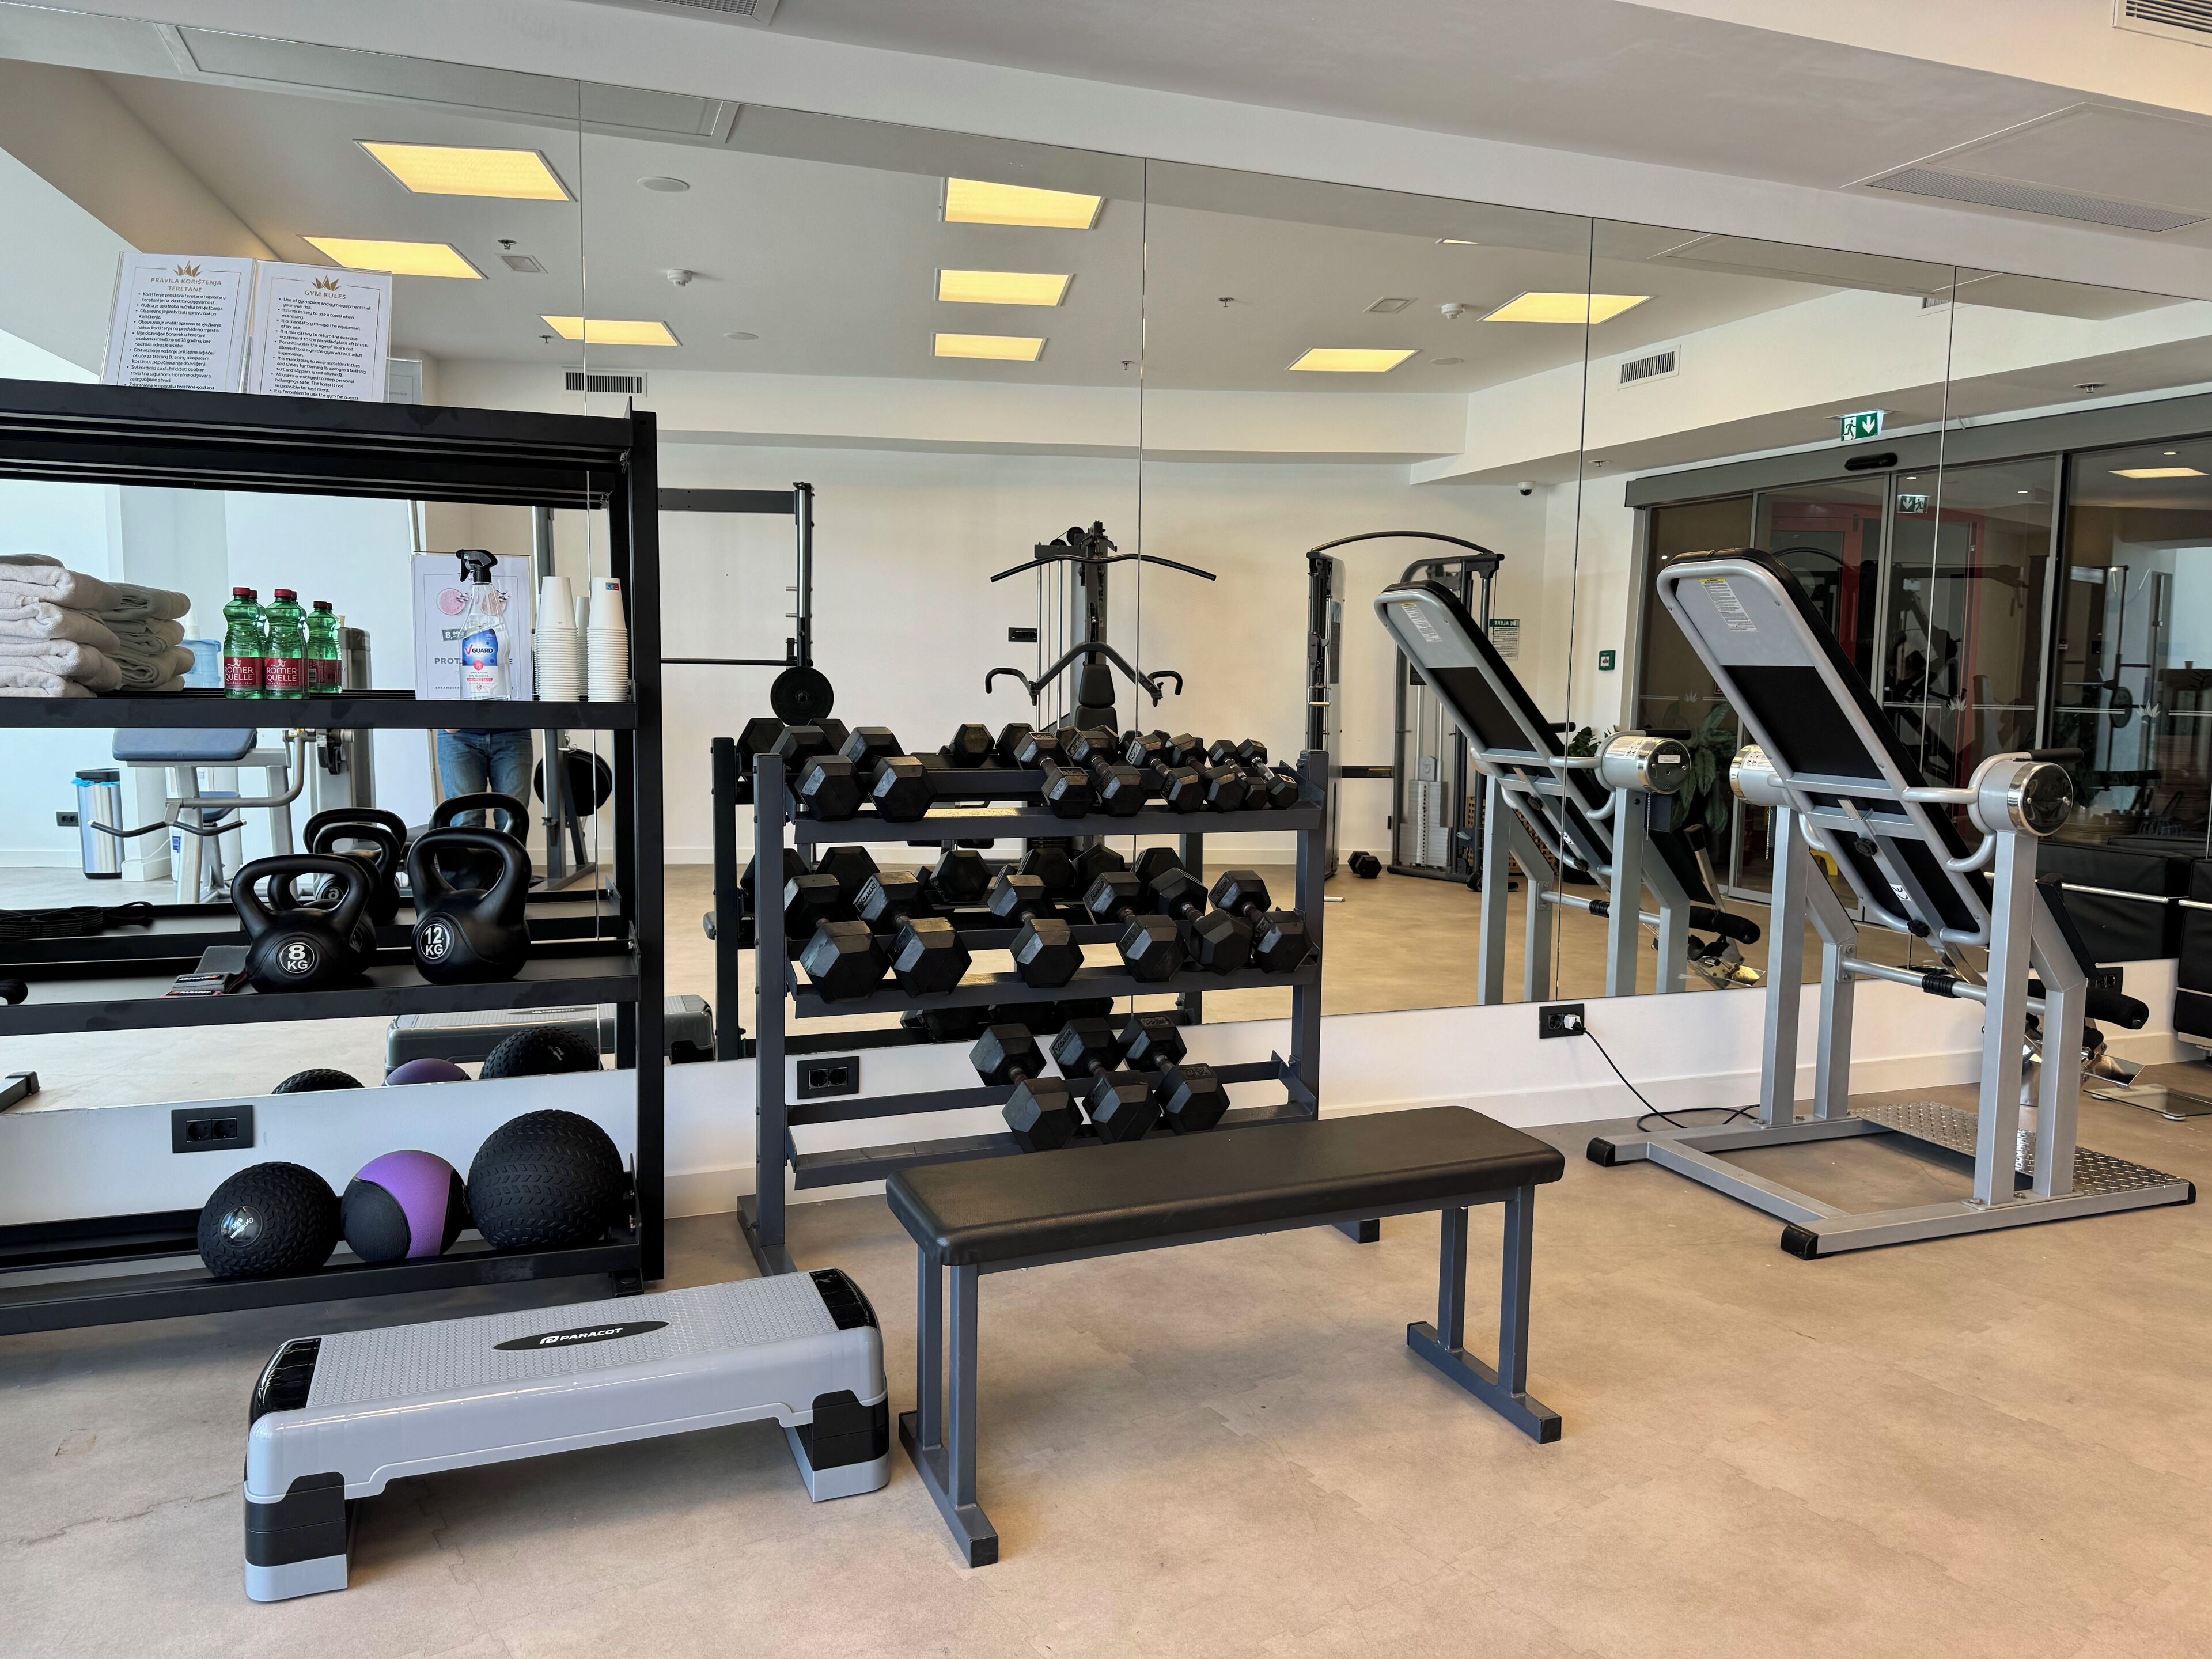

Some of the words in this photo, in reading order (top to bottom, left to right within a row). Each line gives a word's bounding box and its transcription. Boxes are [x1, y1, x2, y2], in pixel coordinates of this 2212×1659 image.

[181, 277, 222, 286] KORIŠTENJA
[425, 927, 442, 944] 12
[288, 945, 306, 960] 8
[426, 944, 443, 955] KG
[287, 960, 308, 970] KG
[560, 1327, 623, 1342] PARACOT
